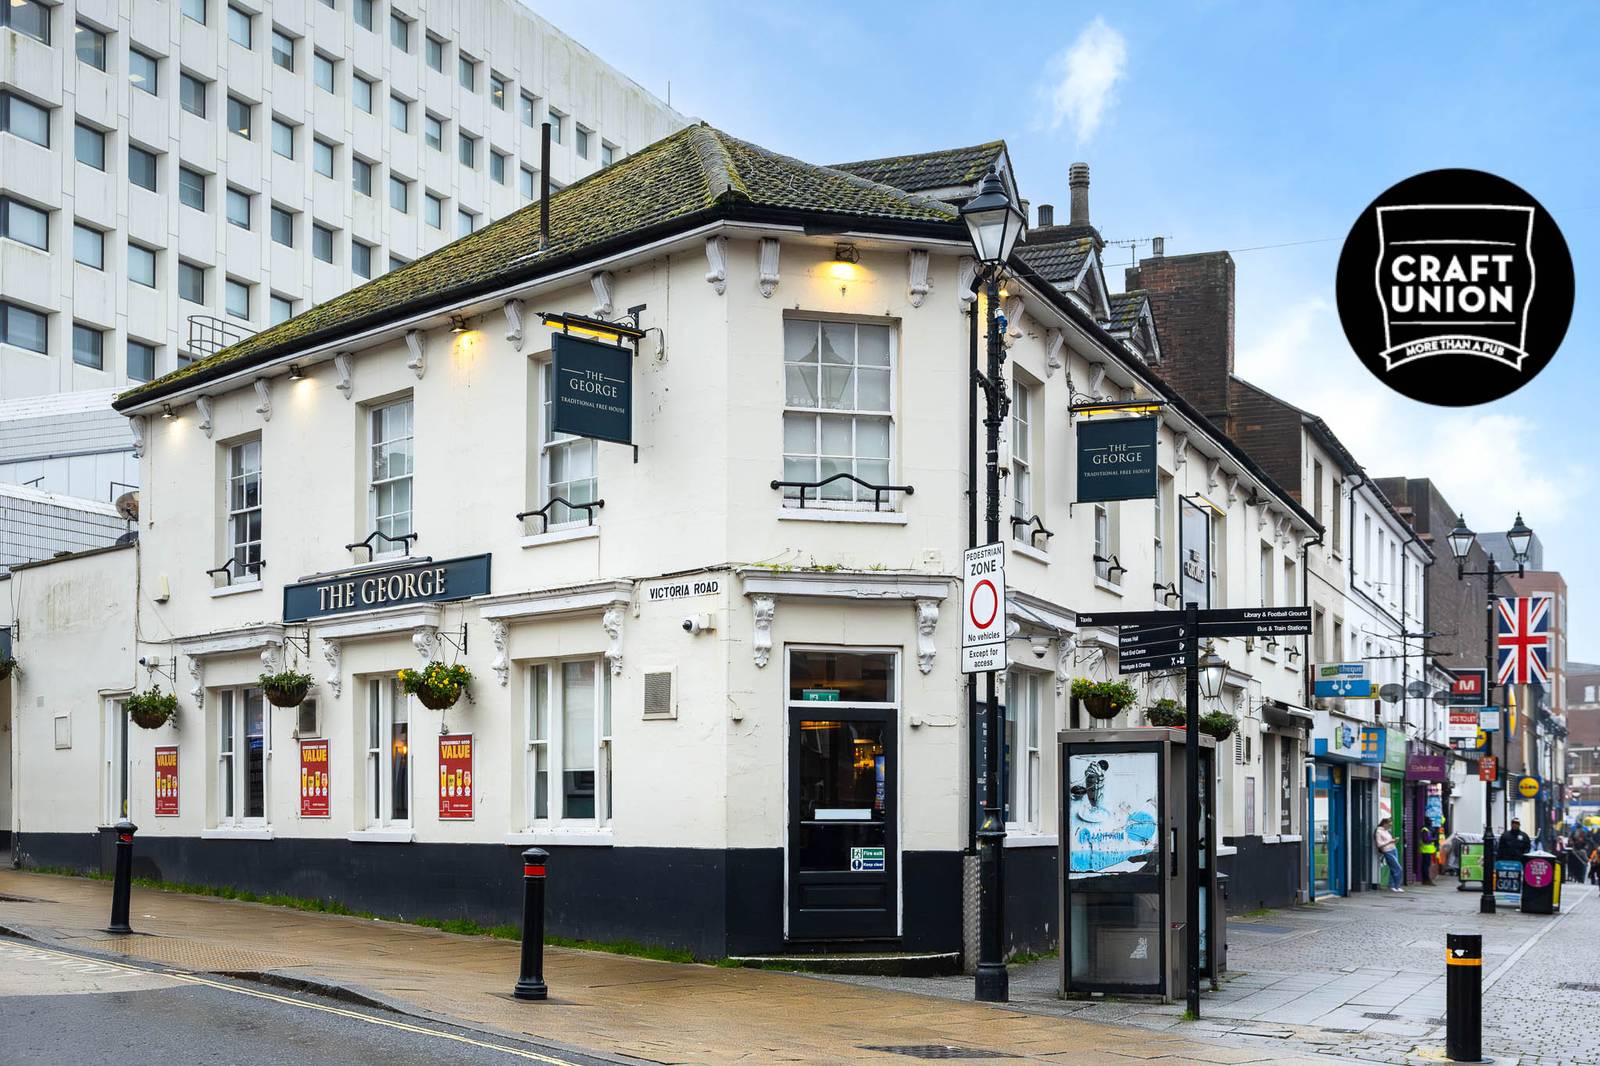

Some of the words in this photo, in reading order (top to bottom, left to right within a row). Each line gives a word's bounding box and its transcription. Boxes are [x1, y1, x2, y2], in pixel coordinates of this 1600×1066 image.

[585, 370, 604, 382] THE
[569, 378, 617, 398] GEORGE
[561, 396, 595, 408] TRADITIONAL
[596, 402, 608, 411] FREE
[608, 404, 625, 414] HOUSE
[1108, 443, 1127, 452] THE
[1092, 452, 1142, 465] GEORGE
[966, 546, 1002, 560] PEDESTRIAN
[970, 560, 997, 576] ZONE
[316, 582, 355, 610] THE
[361, 568, 446, 604] GEORGE
[650, 584, 689, 599] VICTORIA
[694, 581, 719, 595] ROAD
[968, 634, 977, 642] No
[977, 631, 1000, 641] vehicles
[969, 649, 989, 658] Except
[989, 648, 999, 656] for
[974, 660, 993, 668] access
[302, 749, 327, 762] VALUE
[441, 745, 470, 759] VALUE
[157, 754, 176, 767] VALUE
